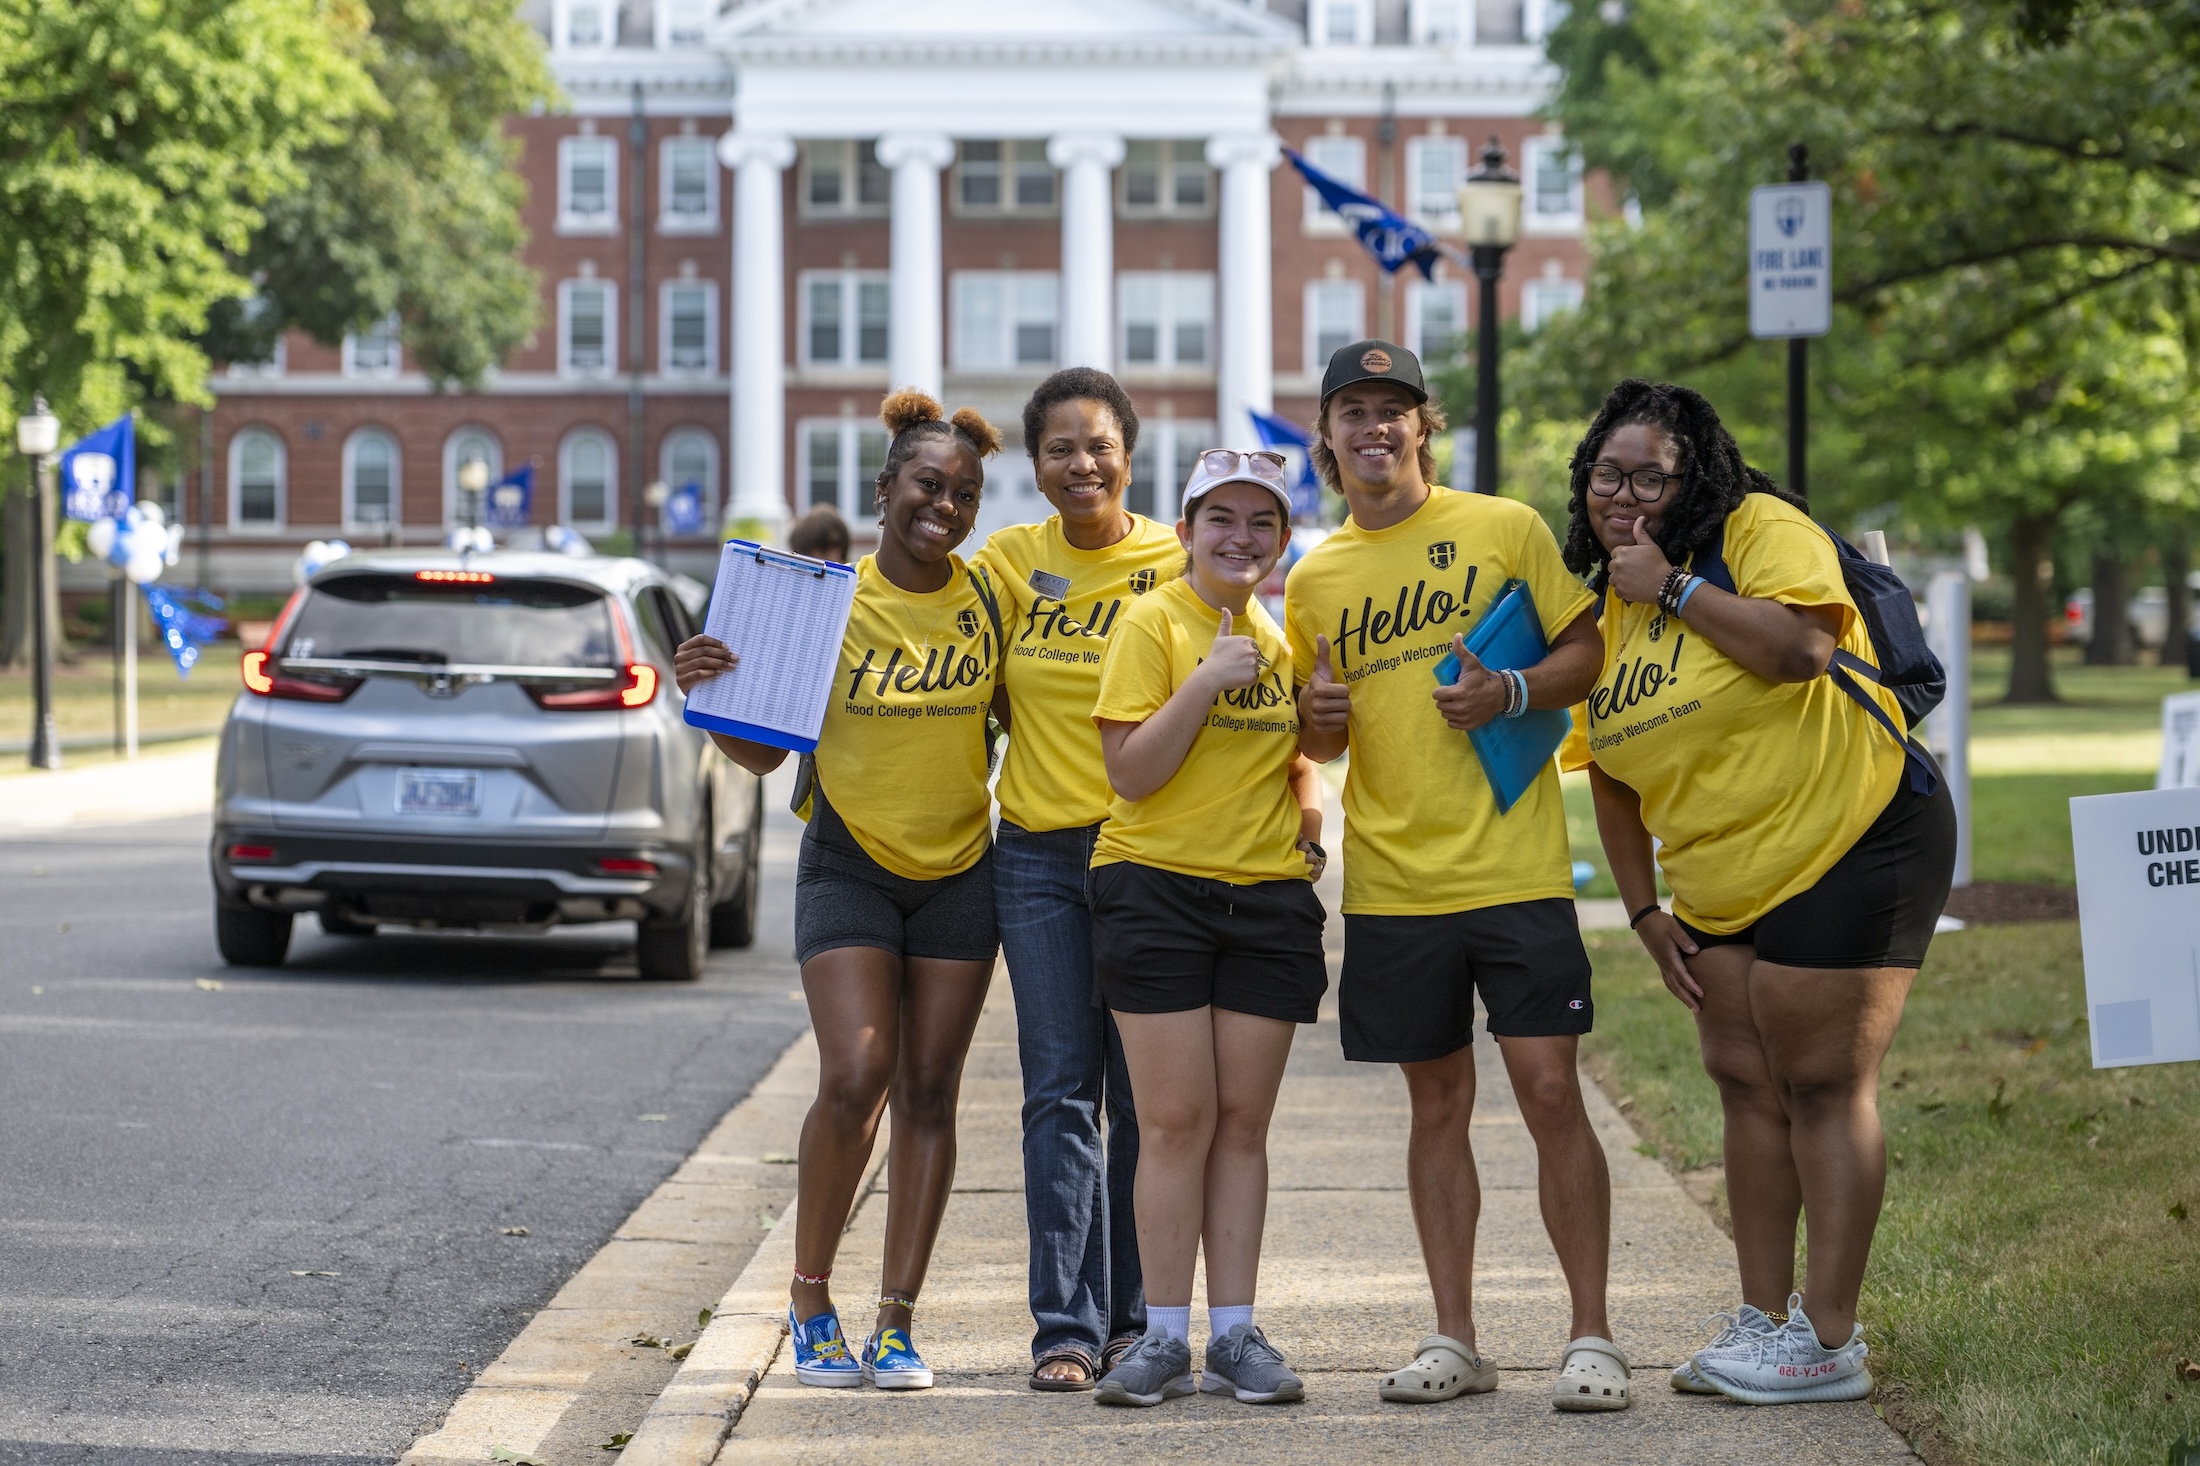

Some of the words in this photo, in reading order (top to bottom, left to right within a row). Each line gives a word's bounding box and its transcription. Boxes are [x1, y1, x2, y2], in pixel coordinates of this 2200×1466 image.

[1757, 248, 1783, 271] FIRE
[1790, 246, 1824, 269] LANE
[1333, 566, 1478, 669] Hello!
[848, 631, 991, 700] Hello!
[1012, 644, 1037, 657] Hood
[1038, 647, 1079, 664] College
[1344, 665, 1365, 684] Hood
[1365, 655, 1401, 676] College
[1402, 641, 1453, 664] Welcome
[845, 701, 874, 717] Hood
[878, 705, 922, 719] College
[926, 704, 977, 717] Welcome
[1211, 713, 1245, 732] College
[1246, 717, 1286, 732] Welcome
[1595, 732, 1624, 750] College
[1622, 713, 1669, 739] Welcome
[1668, 699, 1702, 719] Team
